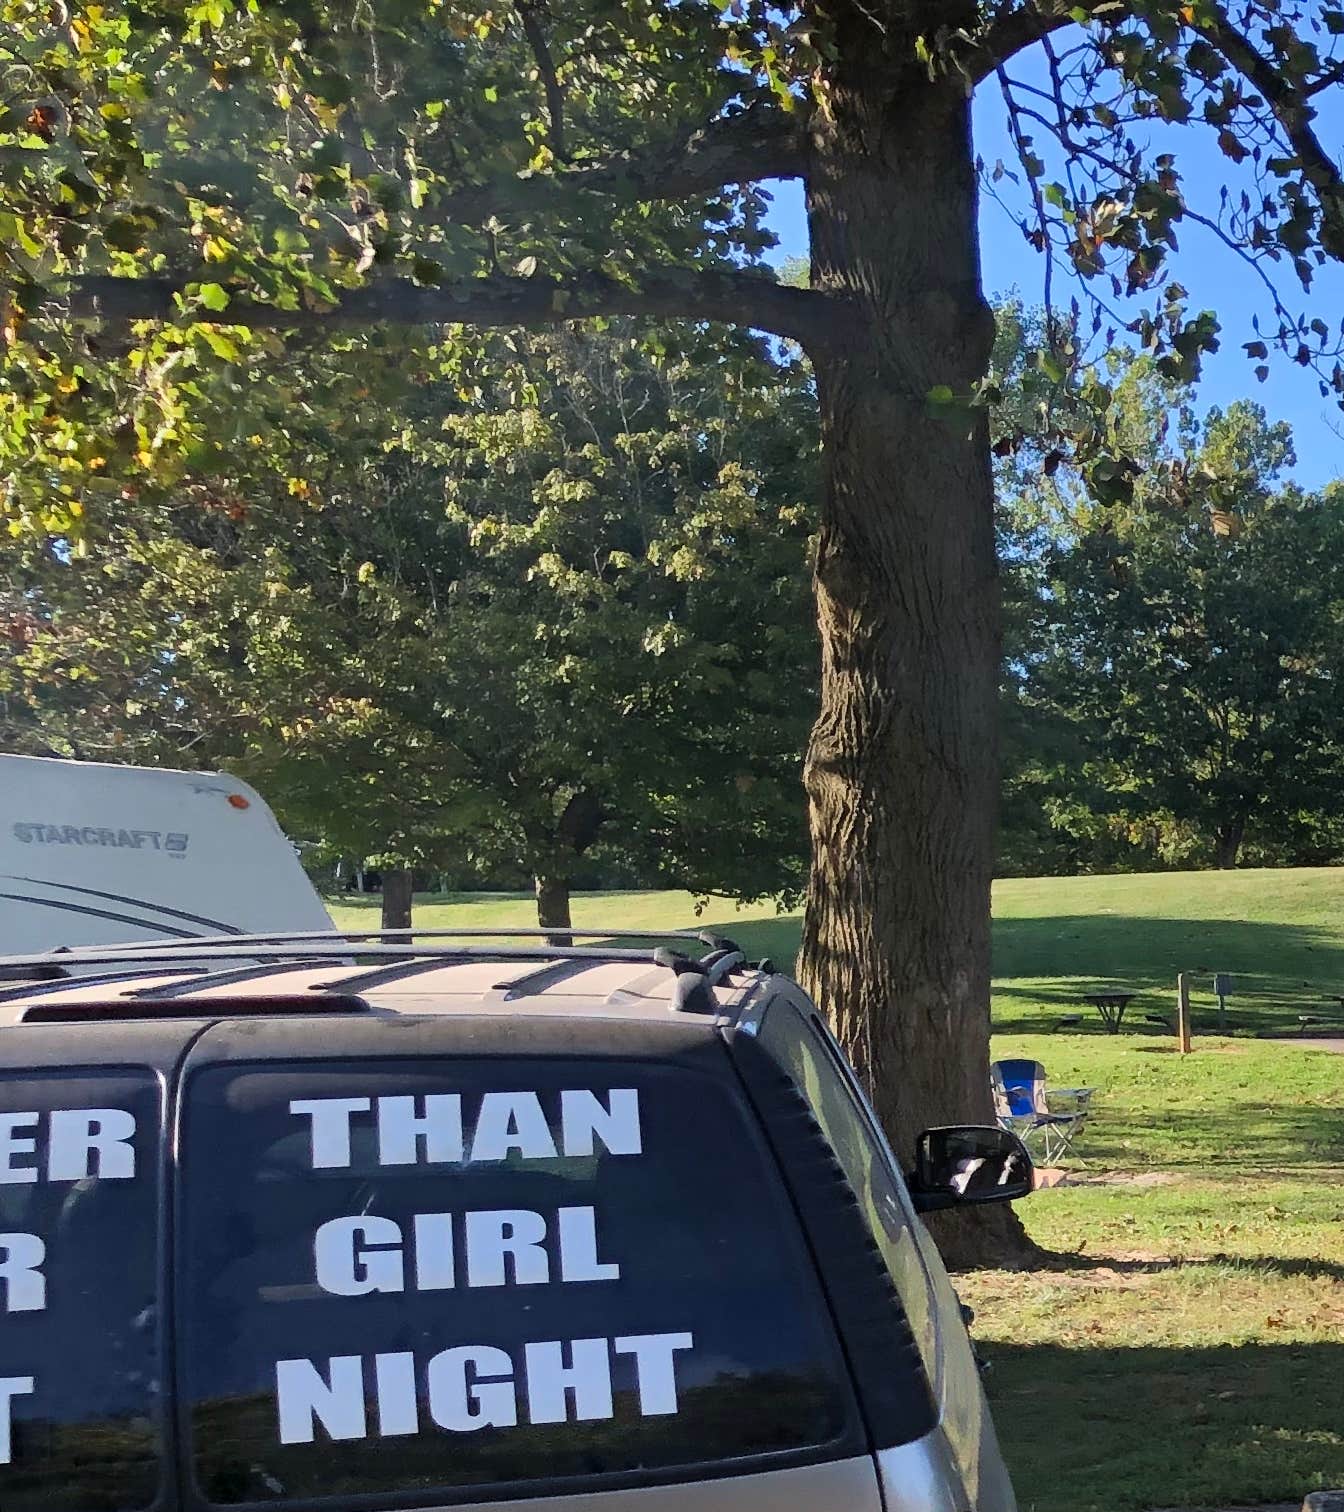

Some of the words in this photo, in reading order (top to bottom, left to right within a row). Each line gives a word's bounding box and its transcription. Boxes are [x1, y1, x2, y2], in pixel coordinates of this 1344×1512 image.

[13, 822, 162, 850] STARCRAFT
[290, 1088, 643, 1169] THAN
[315, 1206, 620, 1296] GIRL
[276, 1333, 694, 1445] NIGHT
